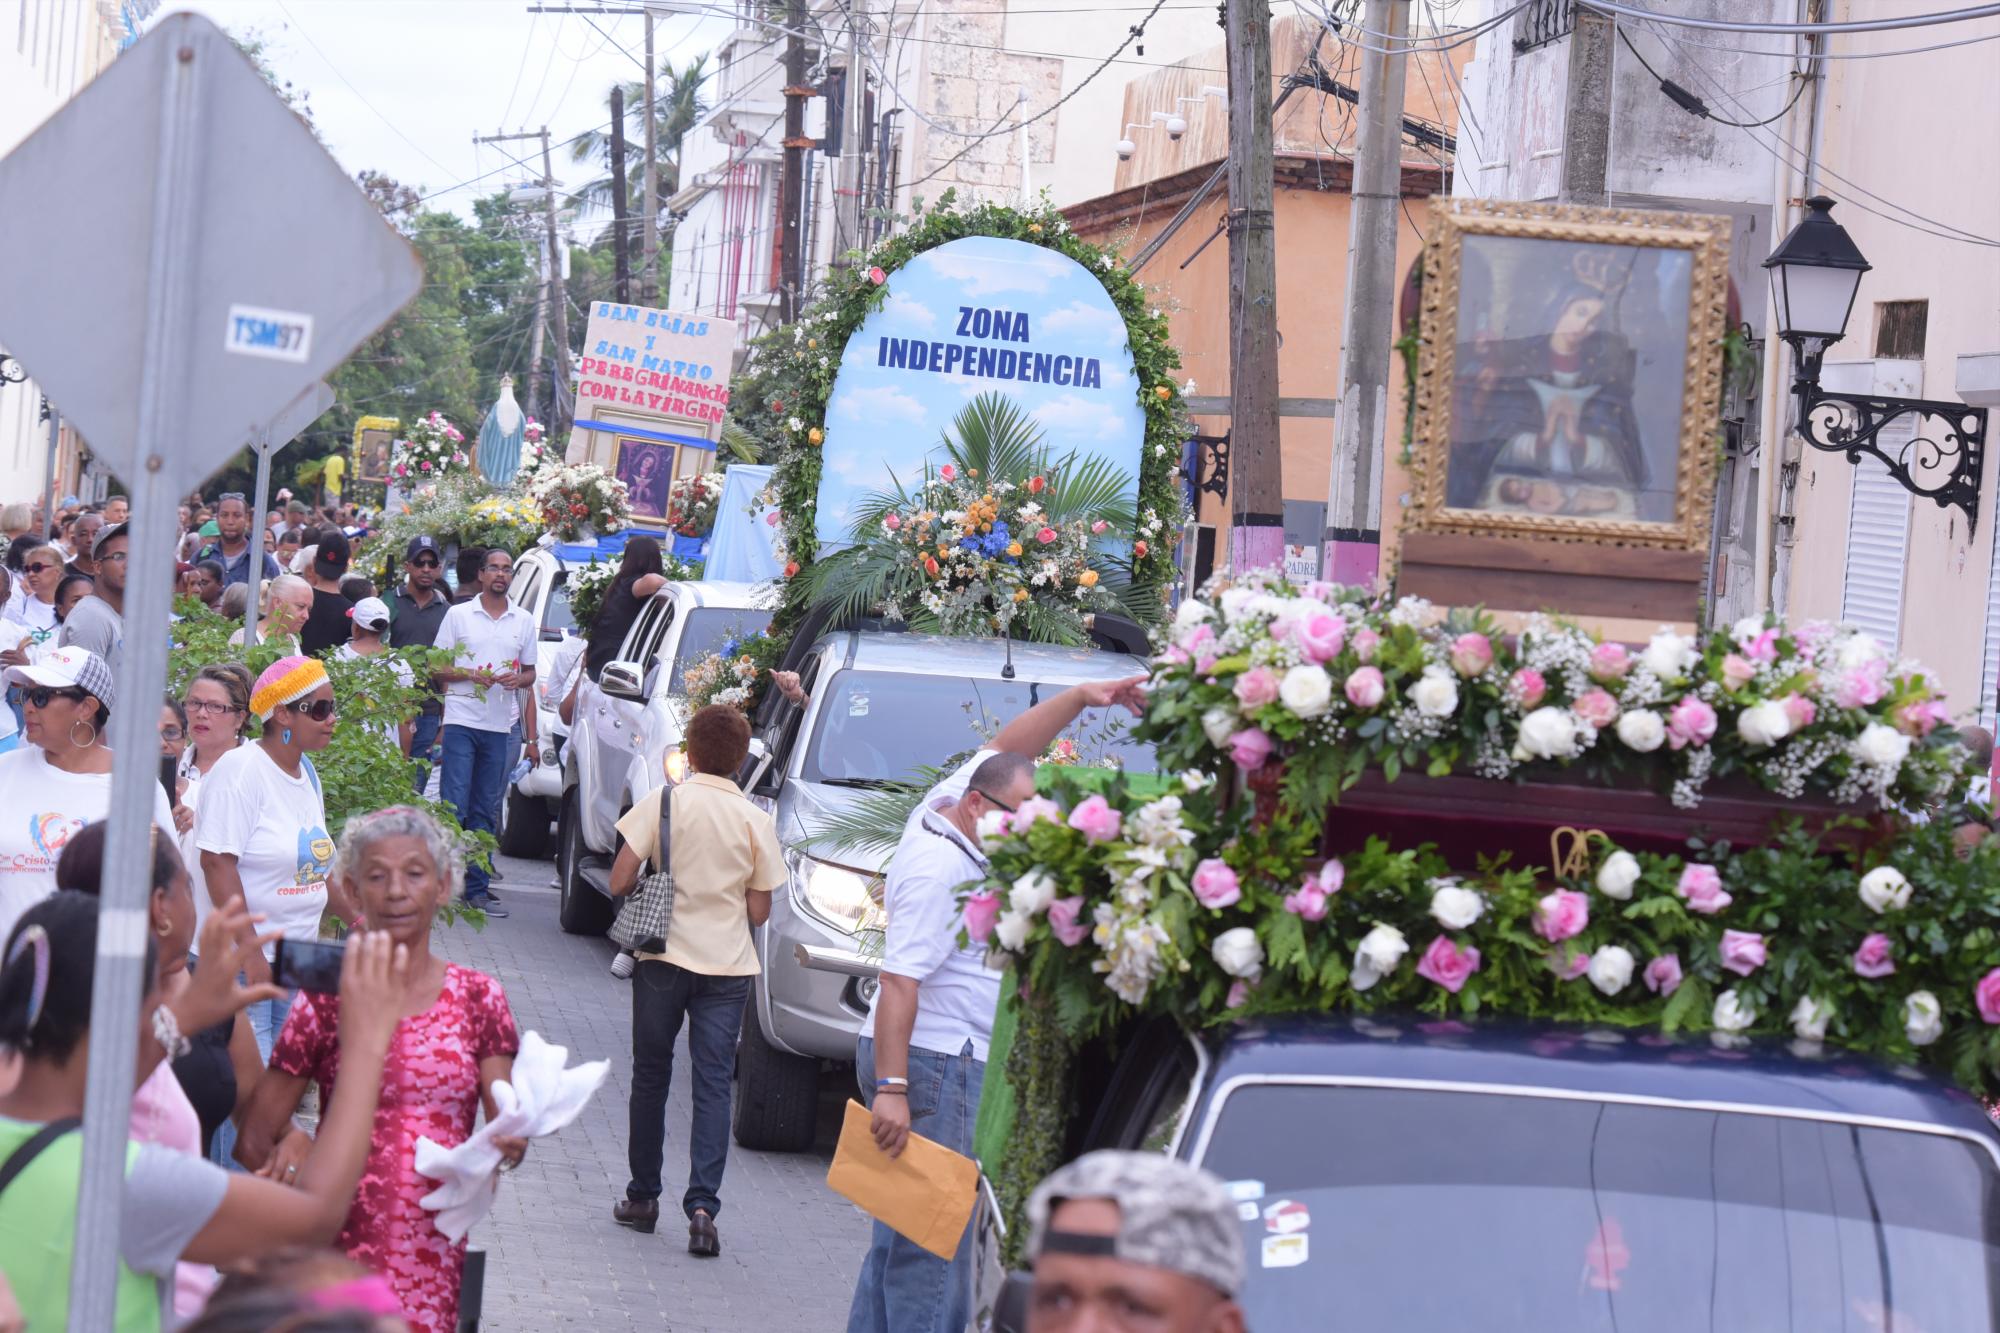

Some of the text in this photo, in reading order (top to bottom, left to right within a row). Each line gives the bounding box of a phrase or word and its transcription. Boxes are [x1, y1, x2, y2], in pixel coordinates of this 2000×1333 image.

[598, 304, 639, 321] SAN
[956, 306, 1030, 343] ZONA
[645, 335, 656, 350] Y
[595, 340, 713, 380] SAN MATEO
[878, 336, 1101, 389] INDEPENDENCIA
[580, 380, 617, 401] CON
[620, 387, 645, 406] LA
[1285, 560, 1317, 576] PADRE
